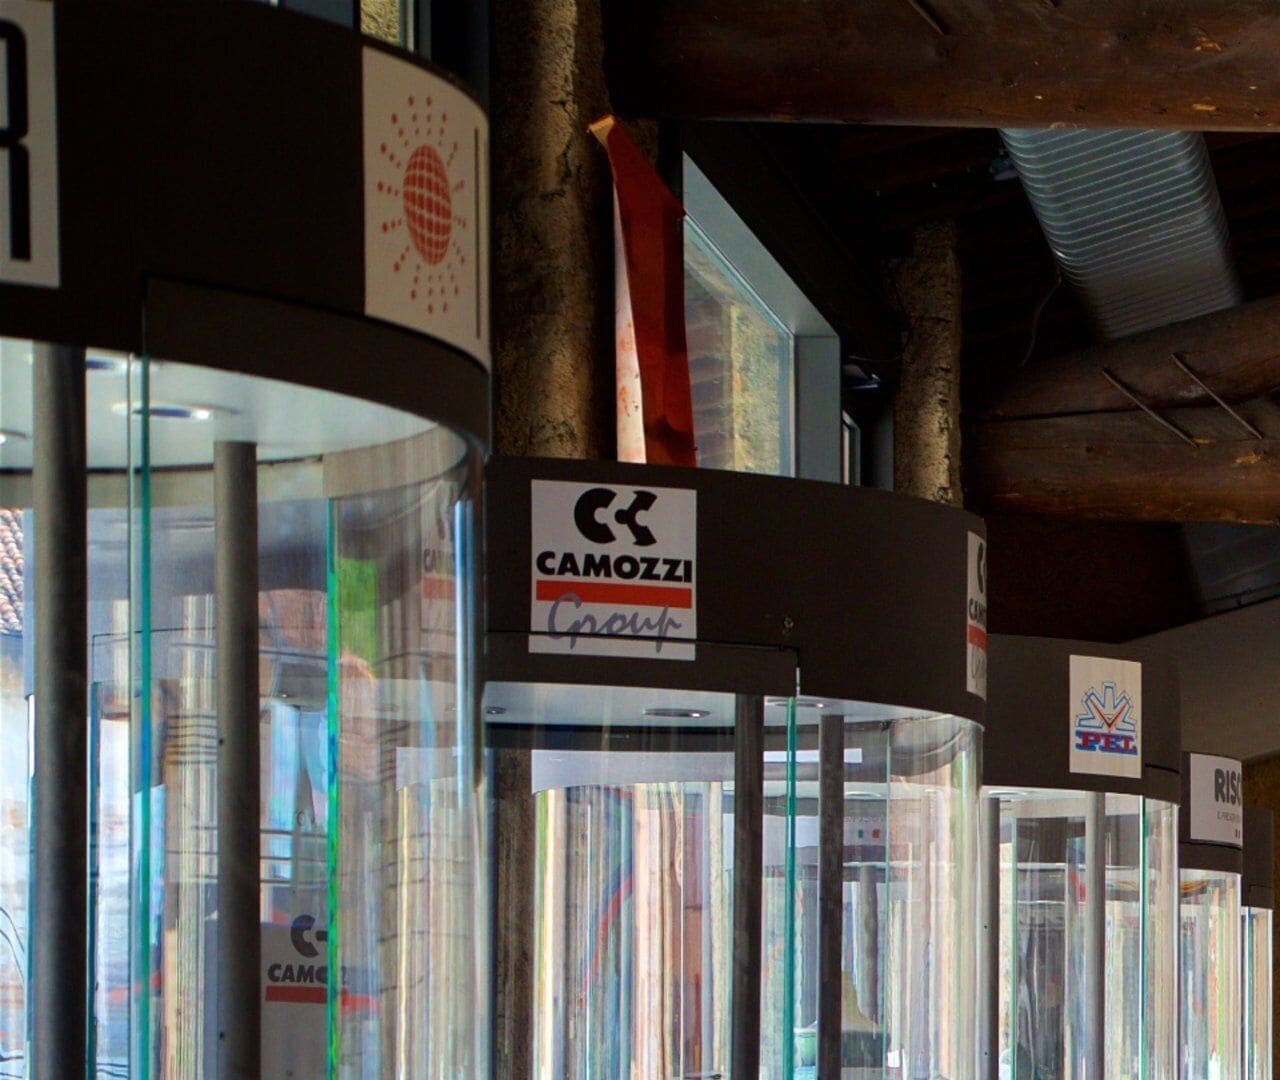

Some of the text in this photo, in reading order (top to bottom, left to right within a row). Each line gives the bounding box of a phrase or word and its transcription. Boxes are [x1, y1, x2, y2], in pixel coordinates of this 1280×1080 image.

[536, 551, 693, 583] CAMOZZI
[547, 592, 682, 653] Group
[1074, 729, 1138, 756] PEL
[267, 963, 347, 986] CAMO
